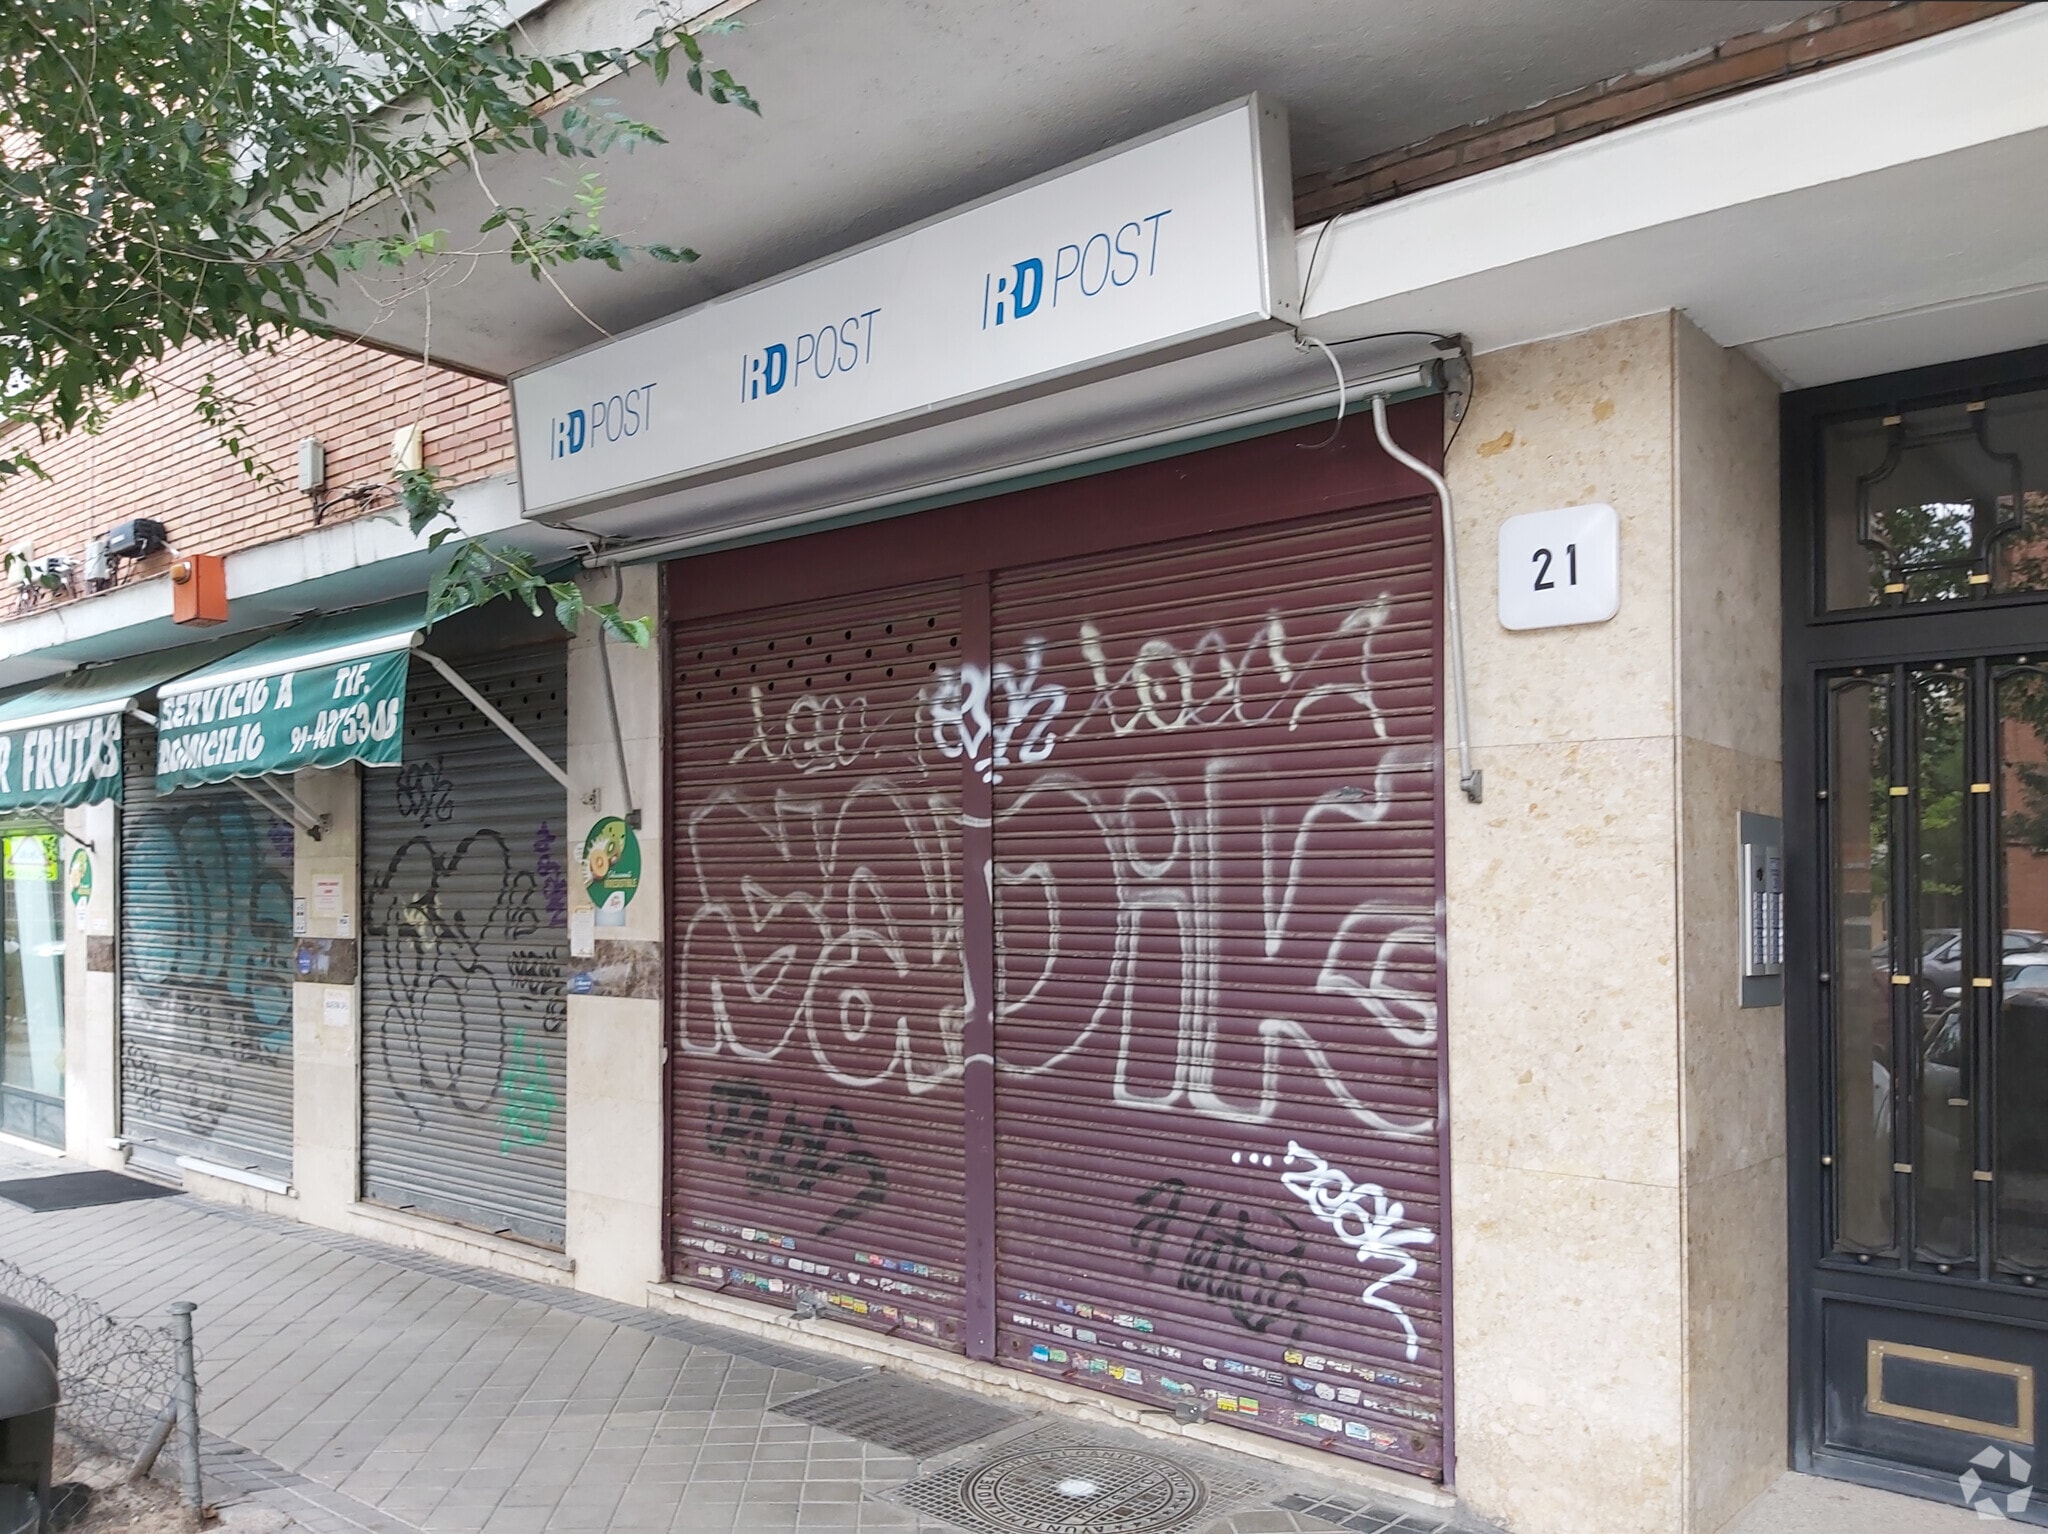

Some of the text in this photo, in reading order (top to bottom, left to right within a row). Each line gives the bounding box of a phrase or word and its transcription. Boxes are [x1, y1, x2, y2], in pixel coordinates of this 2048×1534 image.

[1053, 208, 1173, 308] POST
[794, 307, 882, 387] POST
[590, 382, 658, 448] POST
[1532, 543, 1577, 590] 21
[160, 672, 295, 732] SERVICIO A
[22, 713, 121, 792] FRUTAS
[157, 721, 266, 776] DOMICILIO
